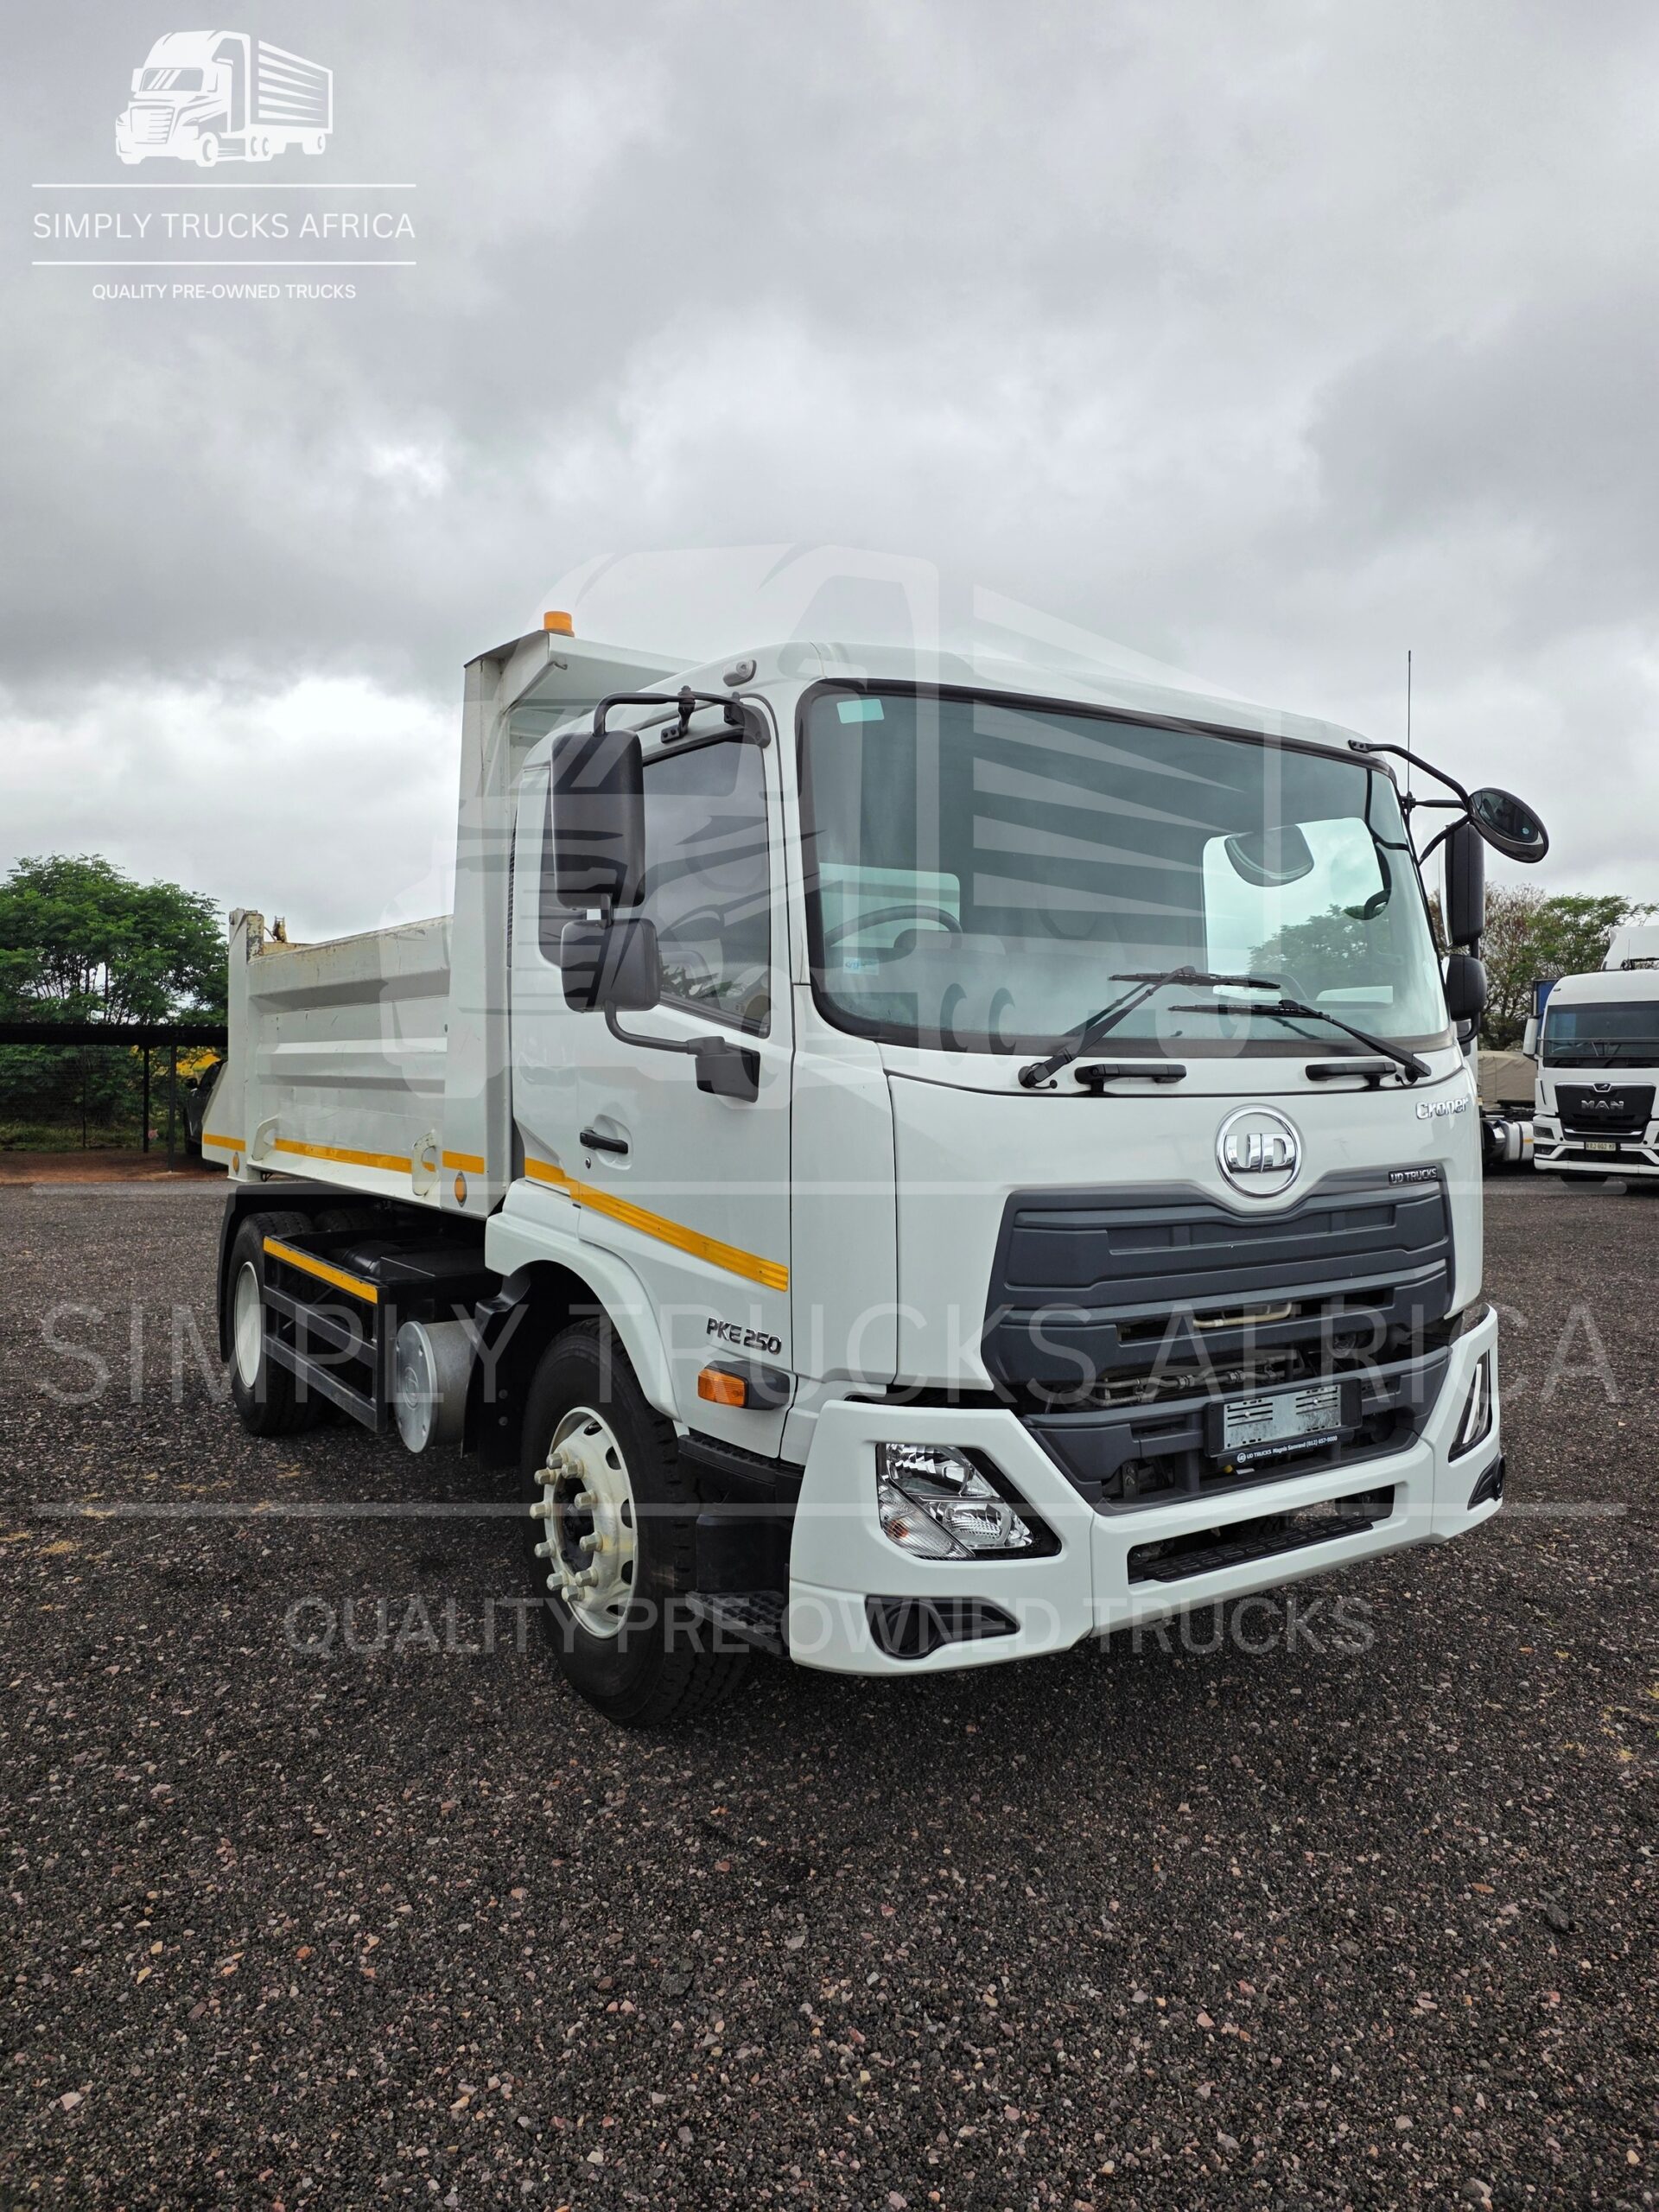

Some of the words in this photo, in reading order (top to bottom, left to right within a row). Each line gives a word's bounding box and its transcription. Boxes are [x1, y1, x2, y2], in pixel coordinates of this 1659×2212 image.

[1416, 1097, 1469, 1120] Croner
[1581, 1100, 1624, 1109] MAN
[1224, 1132, 1296, 1173] UD
[1390, 1172, 1404, 1184] UD
[1404, 1167, 1437, 1182] TRUCKS
[706, 1316, 742, 1344] PKE
[743, 1328, 782, 1356] 250
[1306, 1440, 1318, 1448] (012)
